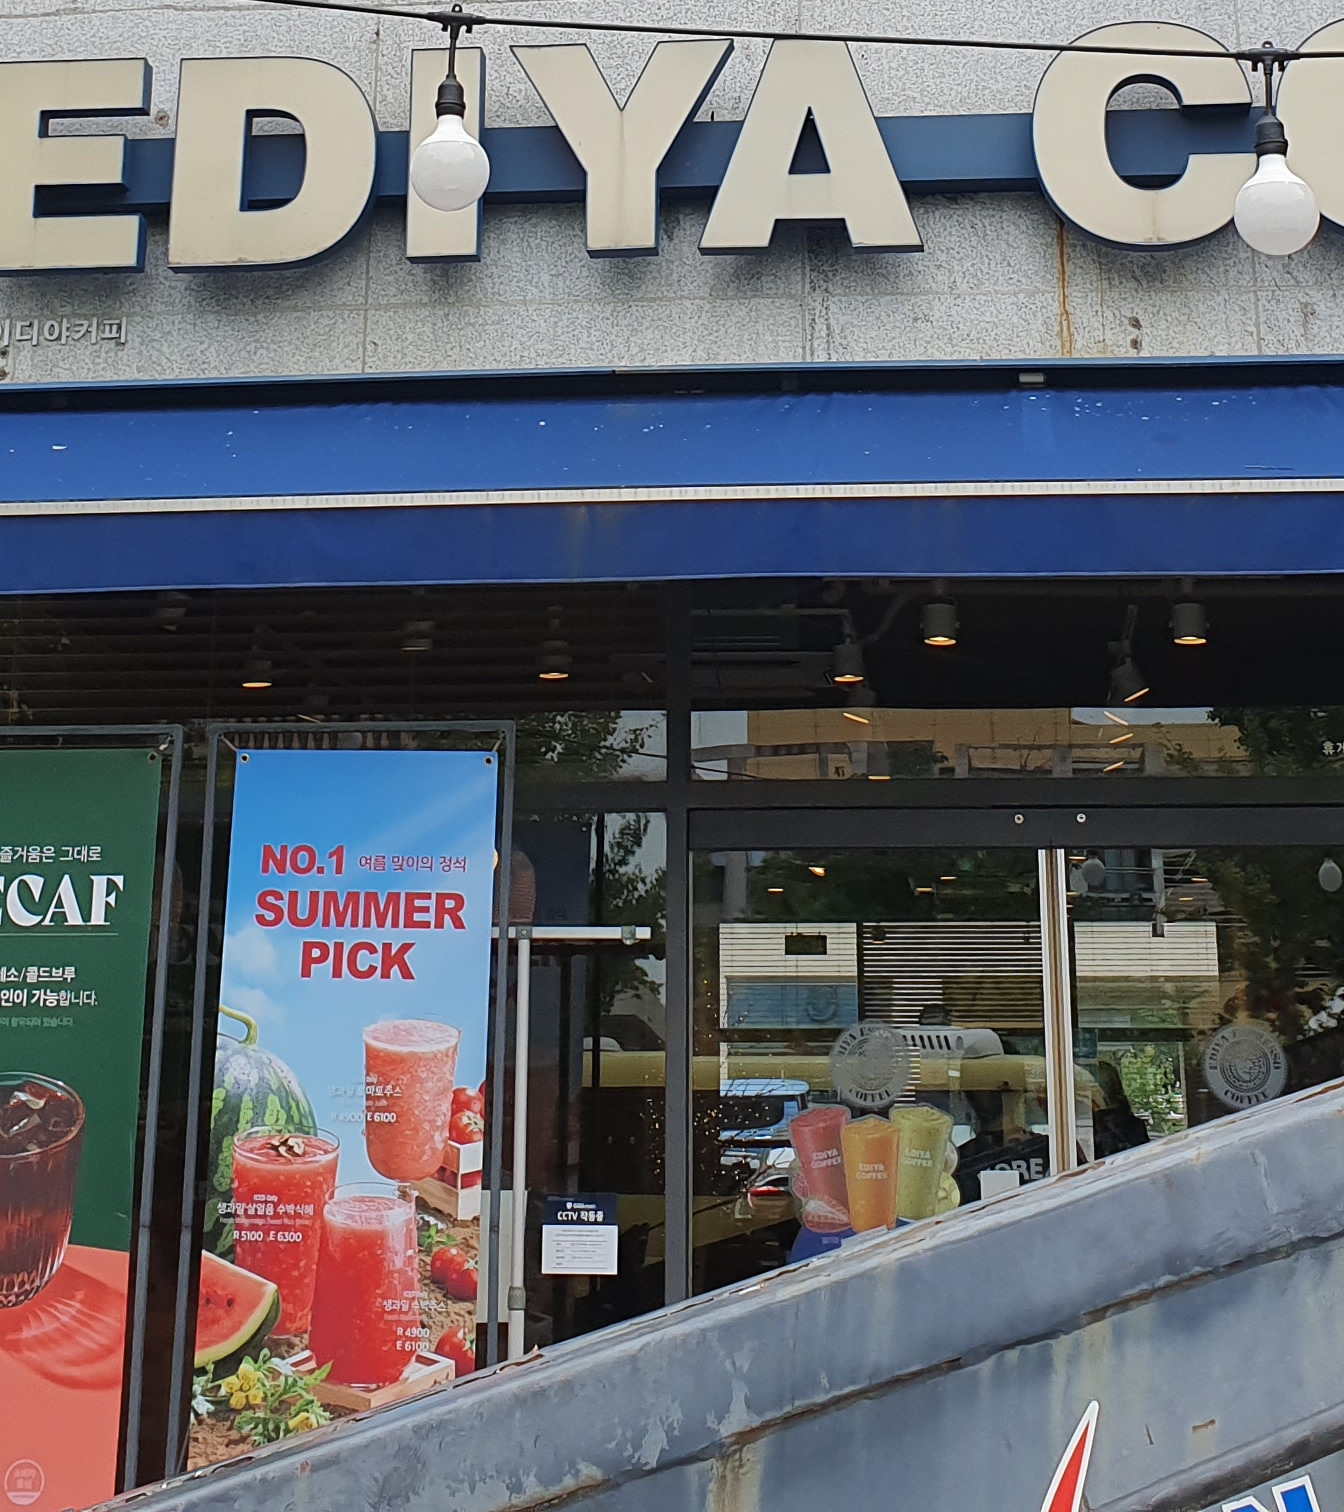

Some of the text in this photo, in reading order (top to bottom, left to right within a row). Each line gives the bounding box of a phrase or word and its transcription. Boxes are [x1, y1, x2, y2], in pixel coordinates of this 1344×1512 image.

[0, 846, 56, 863] 즐거움은
[59, 845, 102, 863] 그대로
[261, 844, 467, 875] NO.1 여름 맞이의 정석
[255, 889, 466, 930] SUMMER
[301, 941, 416, 980] PICK
[31, 989, 98, 1006] 가능합니다.
[557, 1211, 578, 1221] CCTV
